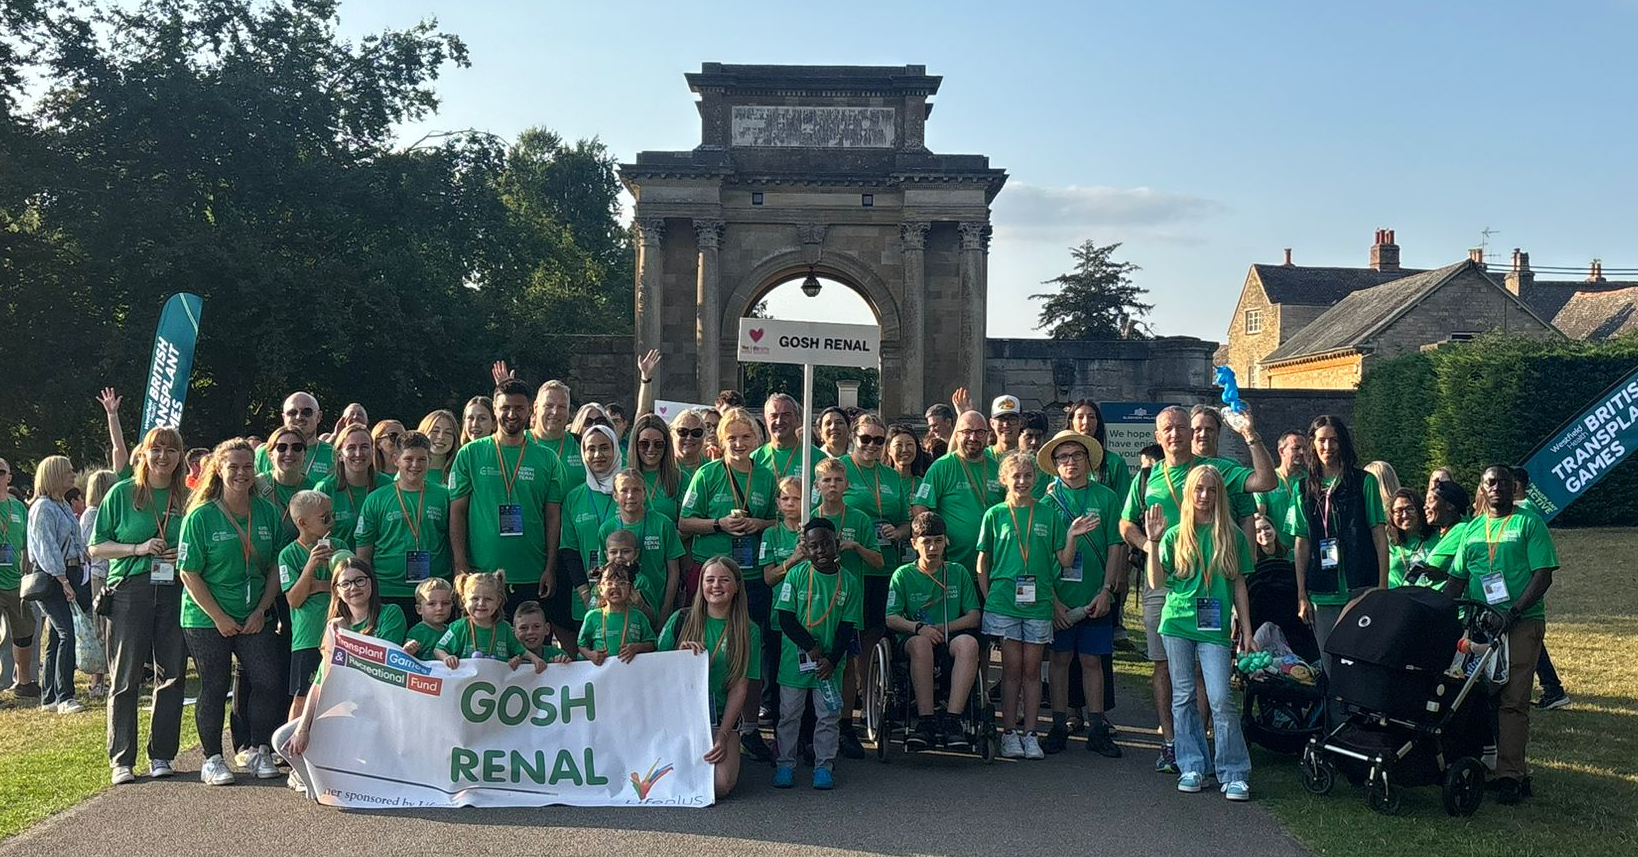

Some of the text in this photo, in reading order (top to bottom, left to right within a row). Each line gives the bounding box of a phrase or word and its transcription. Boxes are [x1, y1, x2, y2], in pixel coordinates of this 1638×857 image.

[779, 336, 871, 352] GOSH RENAL
[148, 335, 169, 402] BRITISH
[154, 343, 180, 430] ANSPLANT
[167, 398, 183, 428] MES
[1584, 378, 1638, 433] BRITIS
[1108, 440, 1156, 448] have enjo
[1109, 429, 1151, 439] We hope
[1550, 424, 1584, 453] Westfield
[1551, 405, 1638, 481] TRANSPLA
[1566, 431, 1589, 450] Health
[1565, 440, 1626, 494] GAMES
[335, 634, 384, 661] Transplant
[334, 651, 438, 693] & Recreational Fund
[459, 681, 596, 728] GOSH
[450, 746, 609, 787] RENAL
[323, 787, 342, 798] ner
[344, 789, 400, 806] sponsored
